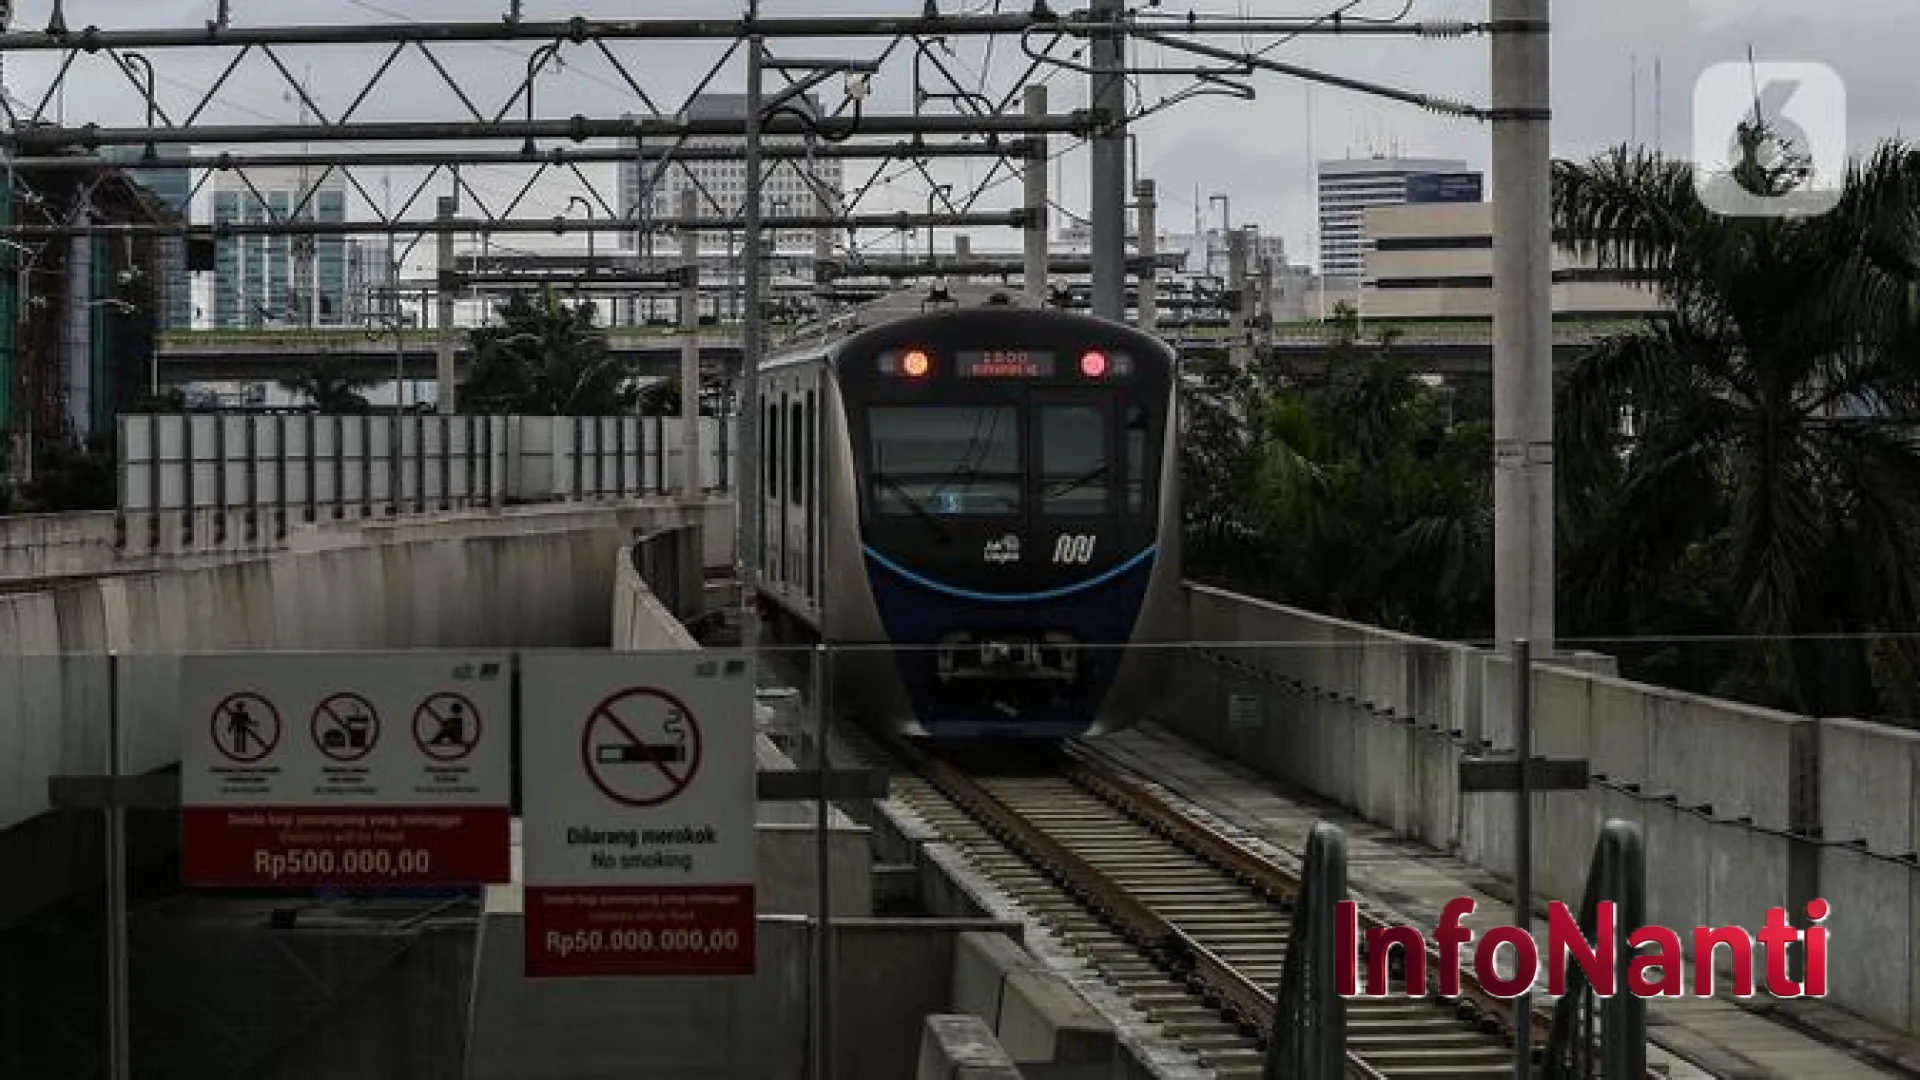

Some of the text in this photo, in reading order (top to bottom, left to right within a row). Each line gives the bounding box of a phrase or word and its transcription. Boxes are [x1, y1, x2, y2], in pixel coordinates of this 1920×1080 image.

[566, 825, 717, 849] Dilarang merokok
[255, 849, 430, 879] Rp500.000,00
[591, 851, 692, 872] No smoking
[546, 929, 739, 958] Rp50.000.000,00
